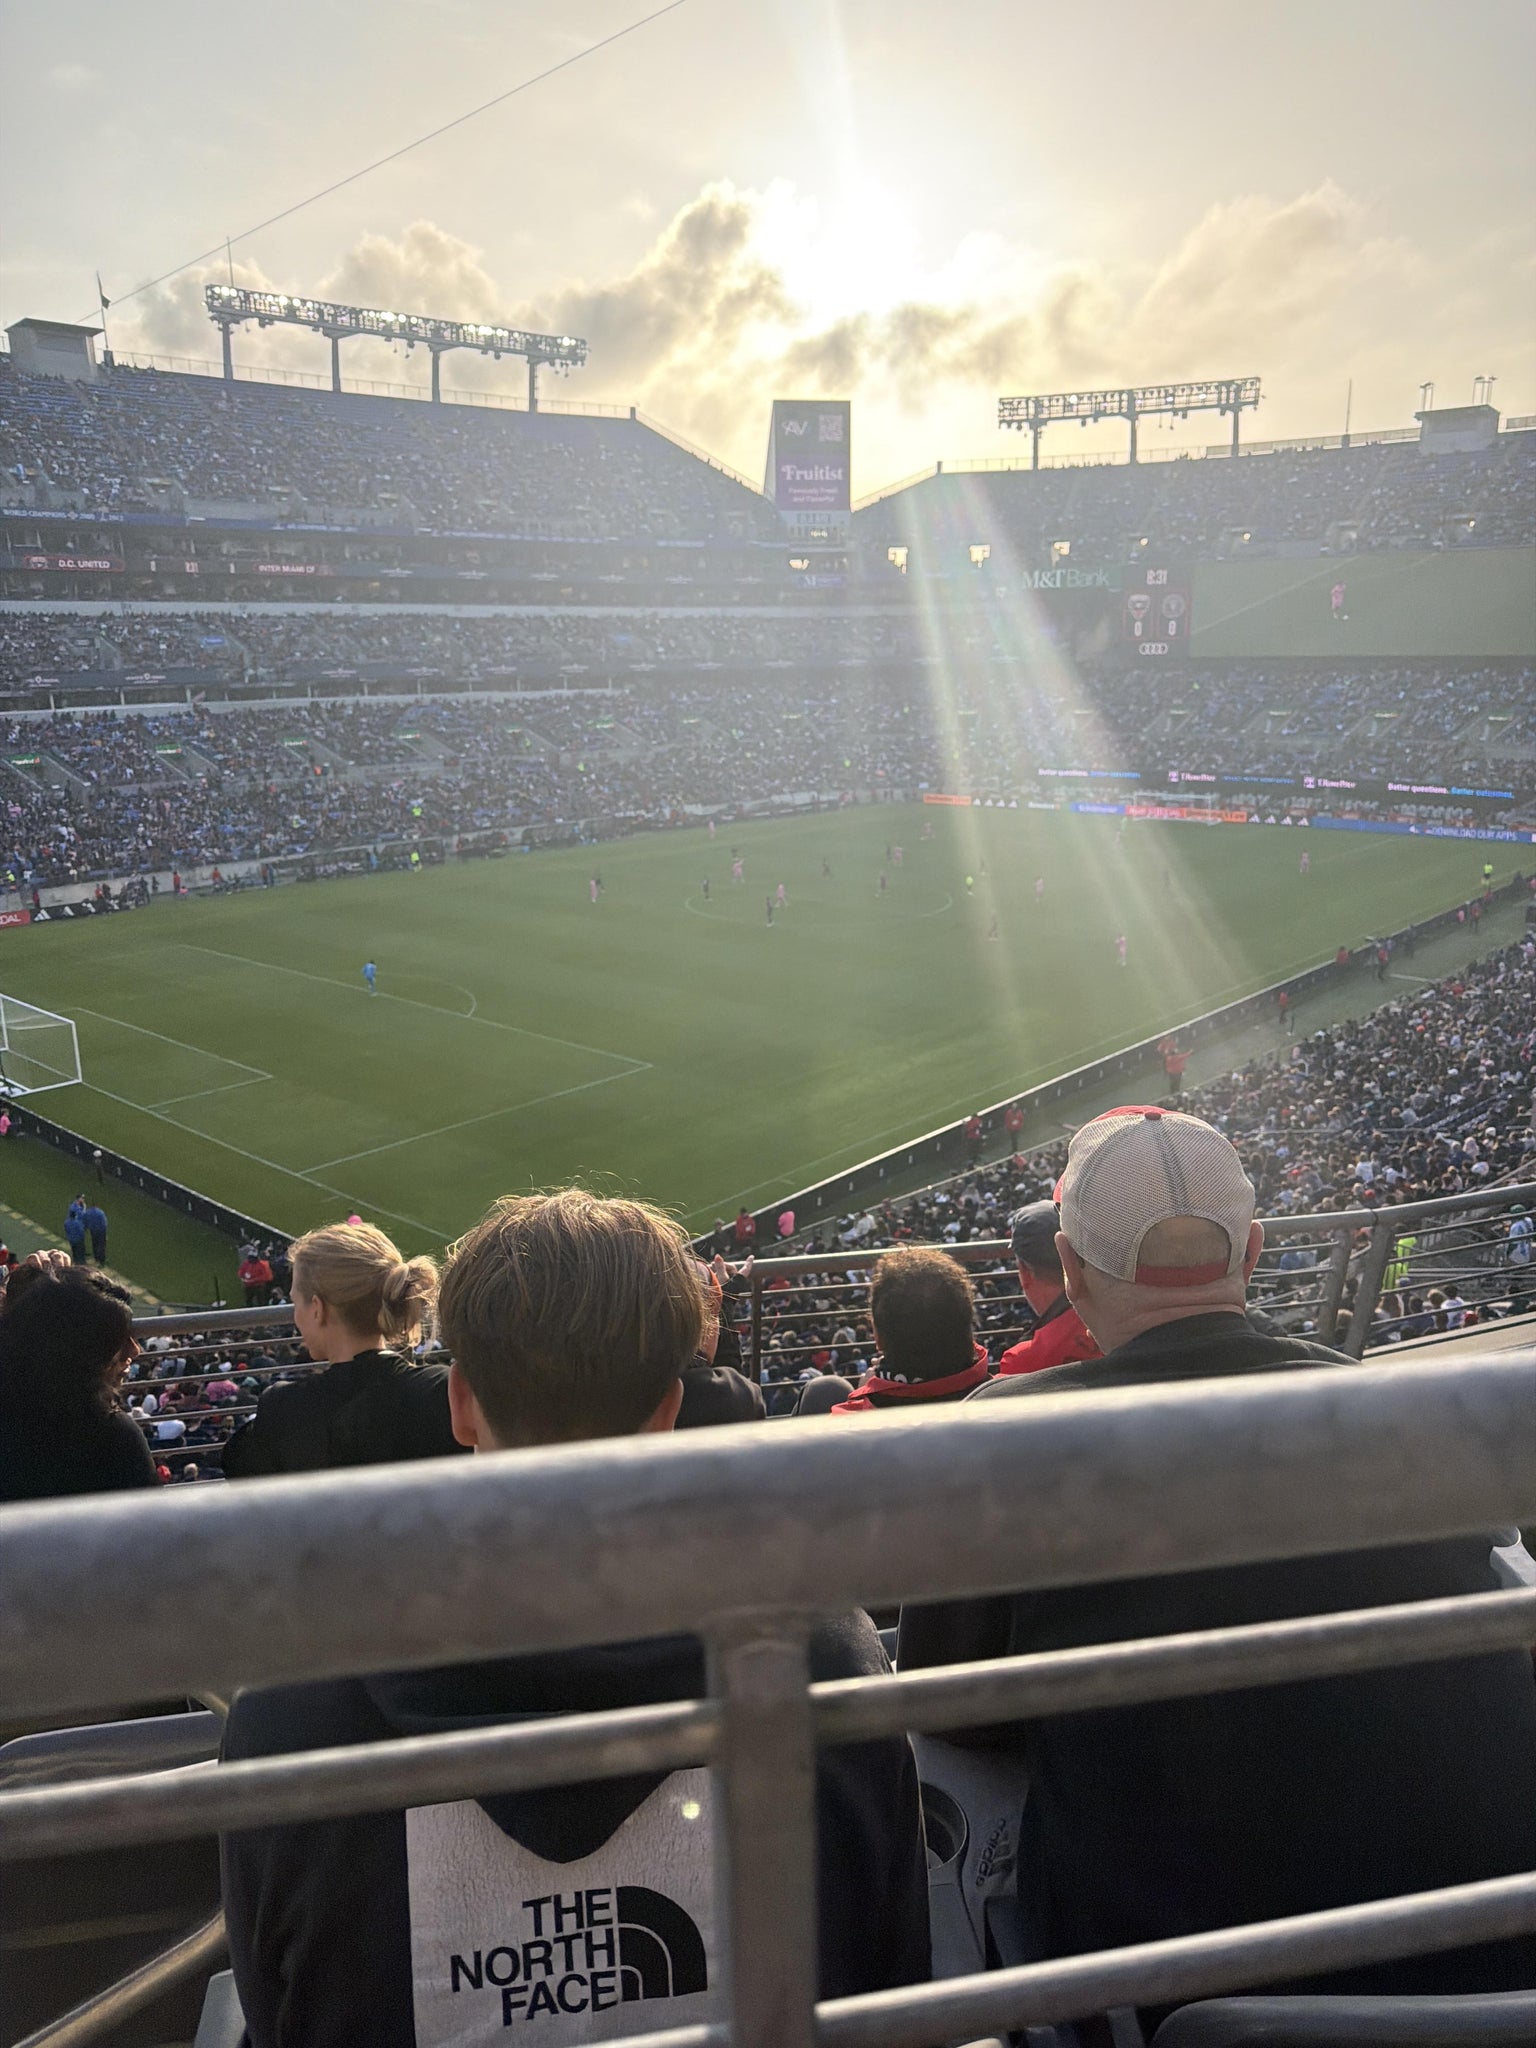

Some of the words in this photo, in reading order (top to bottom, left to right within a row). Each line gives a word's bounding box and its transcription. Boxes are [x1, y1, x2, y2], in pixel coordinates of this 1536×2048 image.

[781, 464, 843, 480] Fruitist
[58, 559, 76, 568] D.C.
[77, 560, 111, 569] UNITED
[1022, 569, 1066, 589] M&T
[1067, 567, 1109, 587] Bank
[1146, 569, 1168, 585] 8:31
[1134, 620, 1143, 637] 0
[1168, 619, 1177, 636] 0
[1387, 782, 1410, 792] Better
[522, 1887, 612, 1938] THE
[450, 1927, 616, 1993] NORTH
[501, 1969, 619, 2026] FACE
